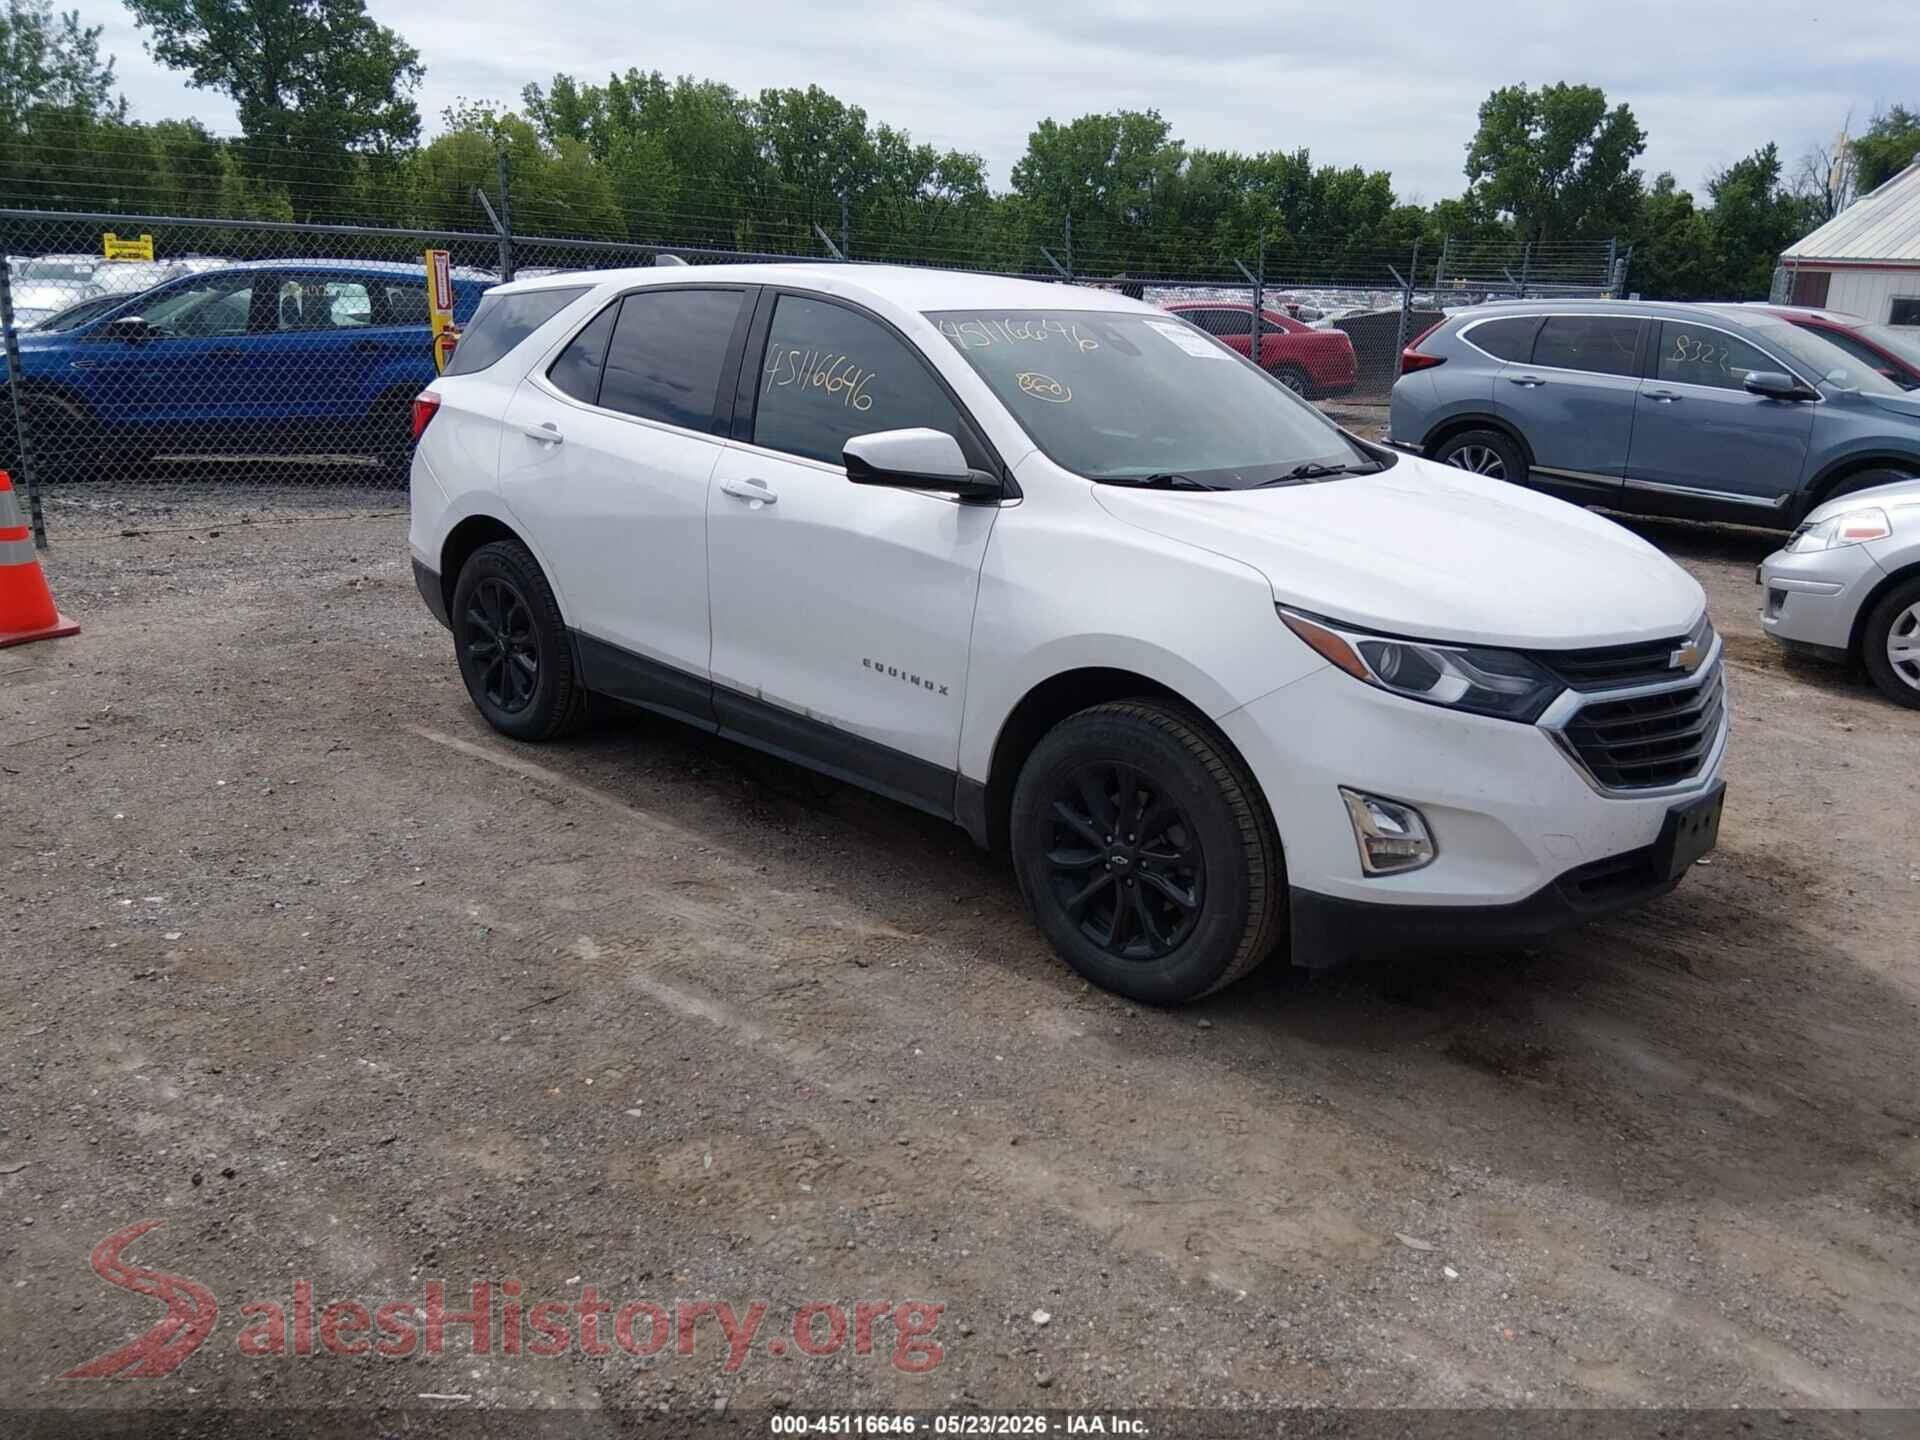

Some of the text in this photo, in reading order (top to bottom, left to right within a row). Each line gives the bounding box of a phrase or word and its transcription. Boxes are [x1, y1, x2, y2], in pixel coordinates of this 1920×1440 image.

[938, 319, 1099, 352] 45116646
[765, 343, 875, 411] 45116646
[862, 657, 949, 696] EQUINOX
